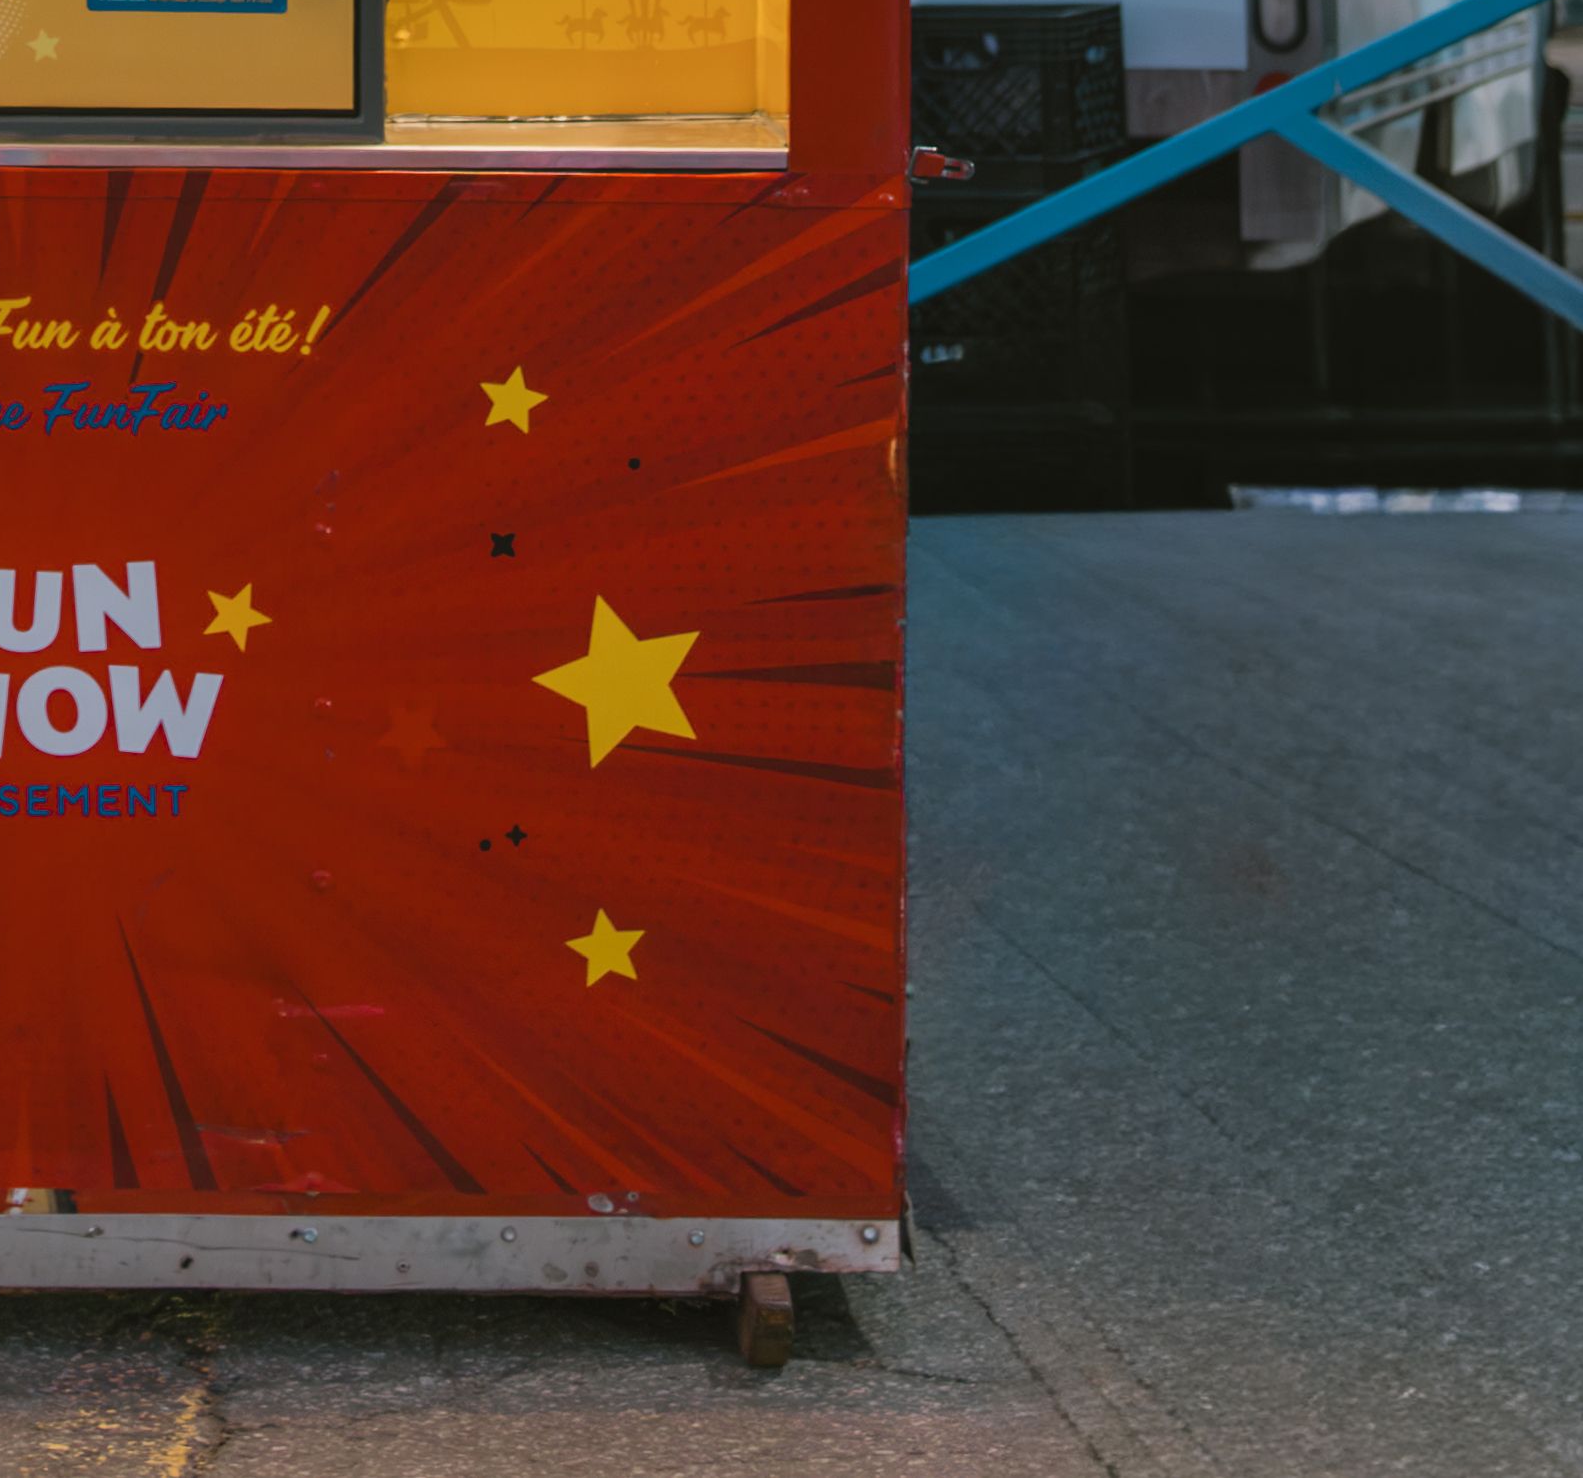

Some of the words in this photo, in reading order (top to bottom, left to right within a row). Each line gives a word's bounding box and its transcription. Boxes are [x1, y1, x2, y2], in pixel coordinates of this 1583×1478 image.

[90, 307, 129, 351] à
[139, 302, 219, 352] ton
[43, 380, 229, 435] FunFair
